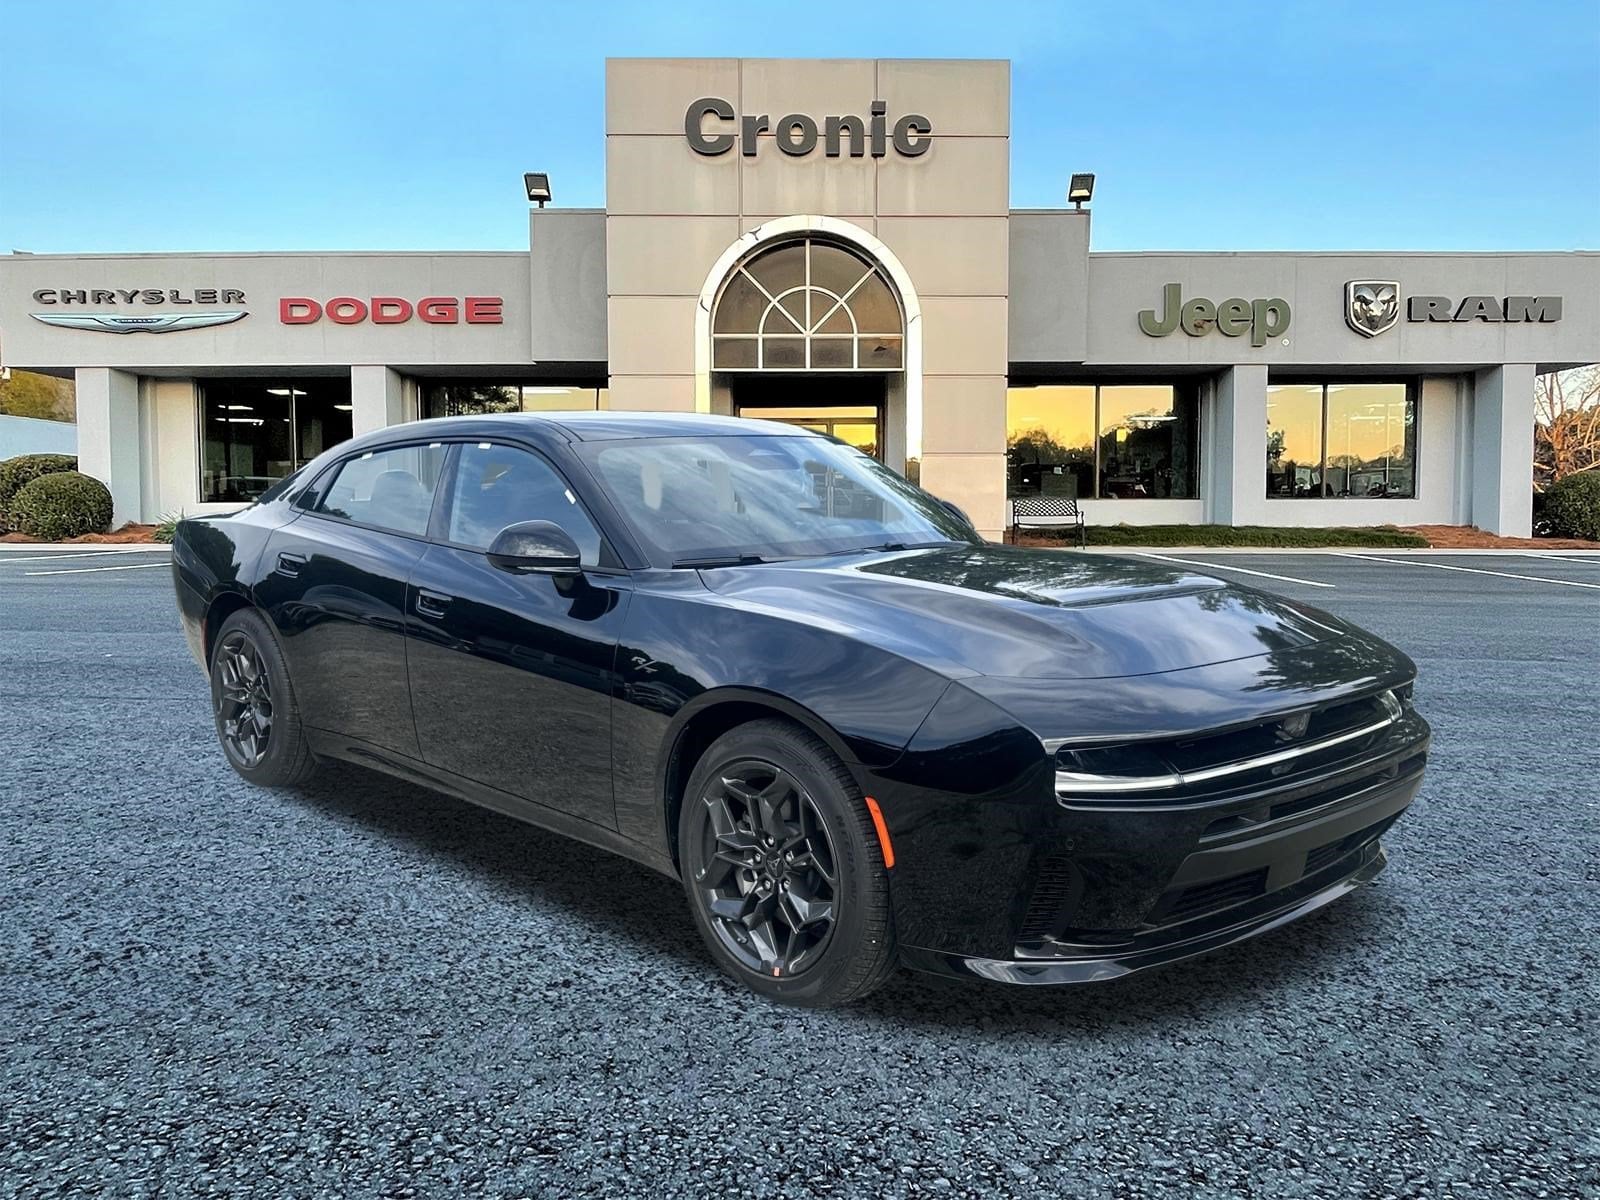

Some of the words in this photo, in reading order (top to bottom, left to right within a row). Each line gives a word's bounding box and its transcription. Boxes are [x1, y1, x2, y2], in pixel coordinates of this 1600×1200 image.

[685, 97, 932, 158] Cronic
[32, 288, 246, 304] CHRYSLER
[1407, 296, 1563, 322] RAM
[280, 297, 503, 324] DODGE
[1138, 283, 1291, 347] Jeep
